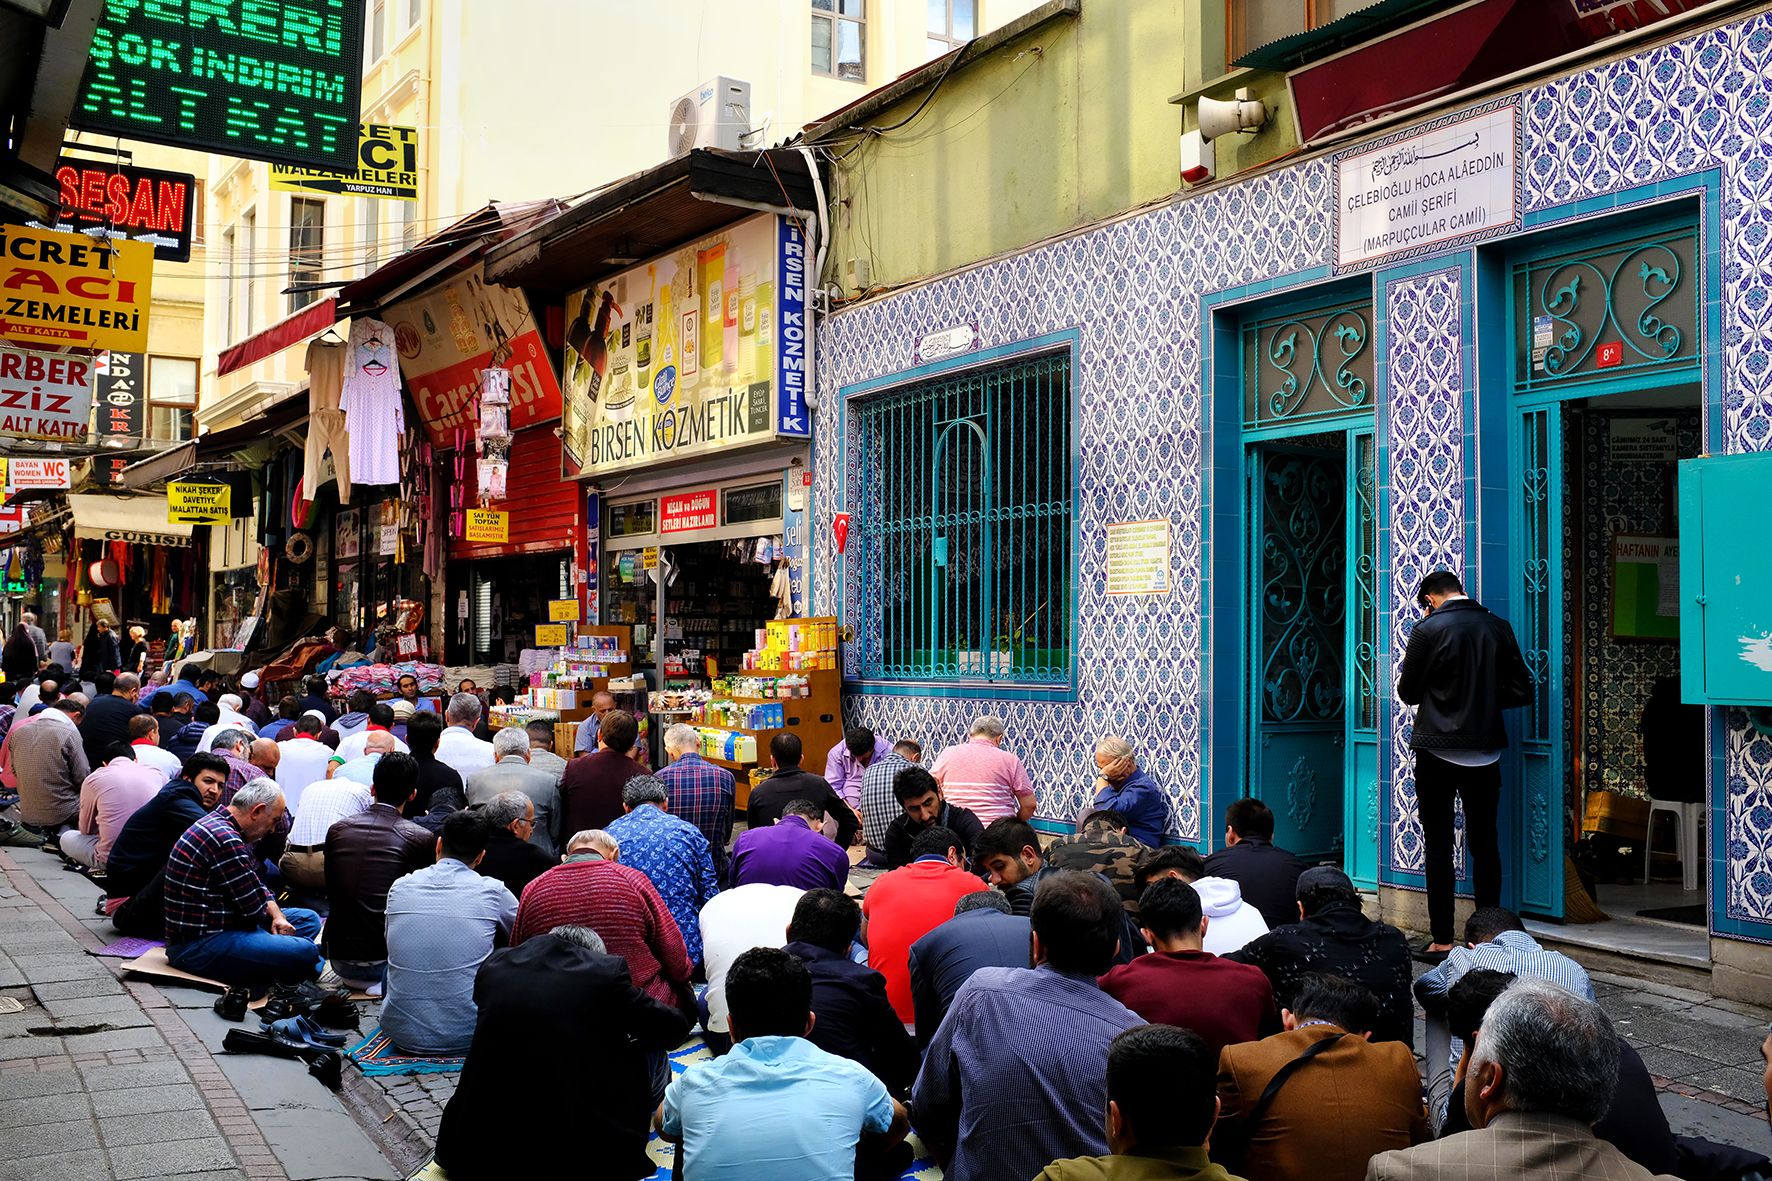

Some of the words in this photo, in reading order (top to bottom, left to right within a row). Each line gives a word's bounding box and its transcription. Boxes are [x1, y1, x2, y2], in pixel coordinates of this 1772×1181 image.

[226, 97, 348, 152] KAT
[346, 183, 376, 194] YARPUZ
[376, 187, 393, 195] HAN
[1347, 178, 1411, 214] ÇELEBİOĞLU
[1415, 170, 1445, 191] HOCA
[1448, 152, 1504, 184] ALÂEDDİN
[1388, 201, 1417, 222] CAMİİ
[1421, 189, 1457, 218] ŞERİFİ
[1363, 218, 1446, 254] (MARPUÇCULAR
[1450, 206, 1486, 230] CAMİİ)
[0, 297, 140, 332] ZEMELERİ
[10, 325, 31, 333] ALT
[34, 327, 70, 338] KATTA
[1, 415, 33, 433] ALT
[591, 416, 645, 464] BİRSEN
[651, 388, 746, 453] KOZMETİK
[43, 461, 65, 477] WC
[209, 506, 229, 516] SATIŞ
